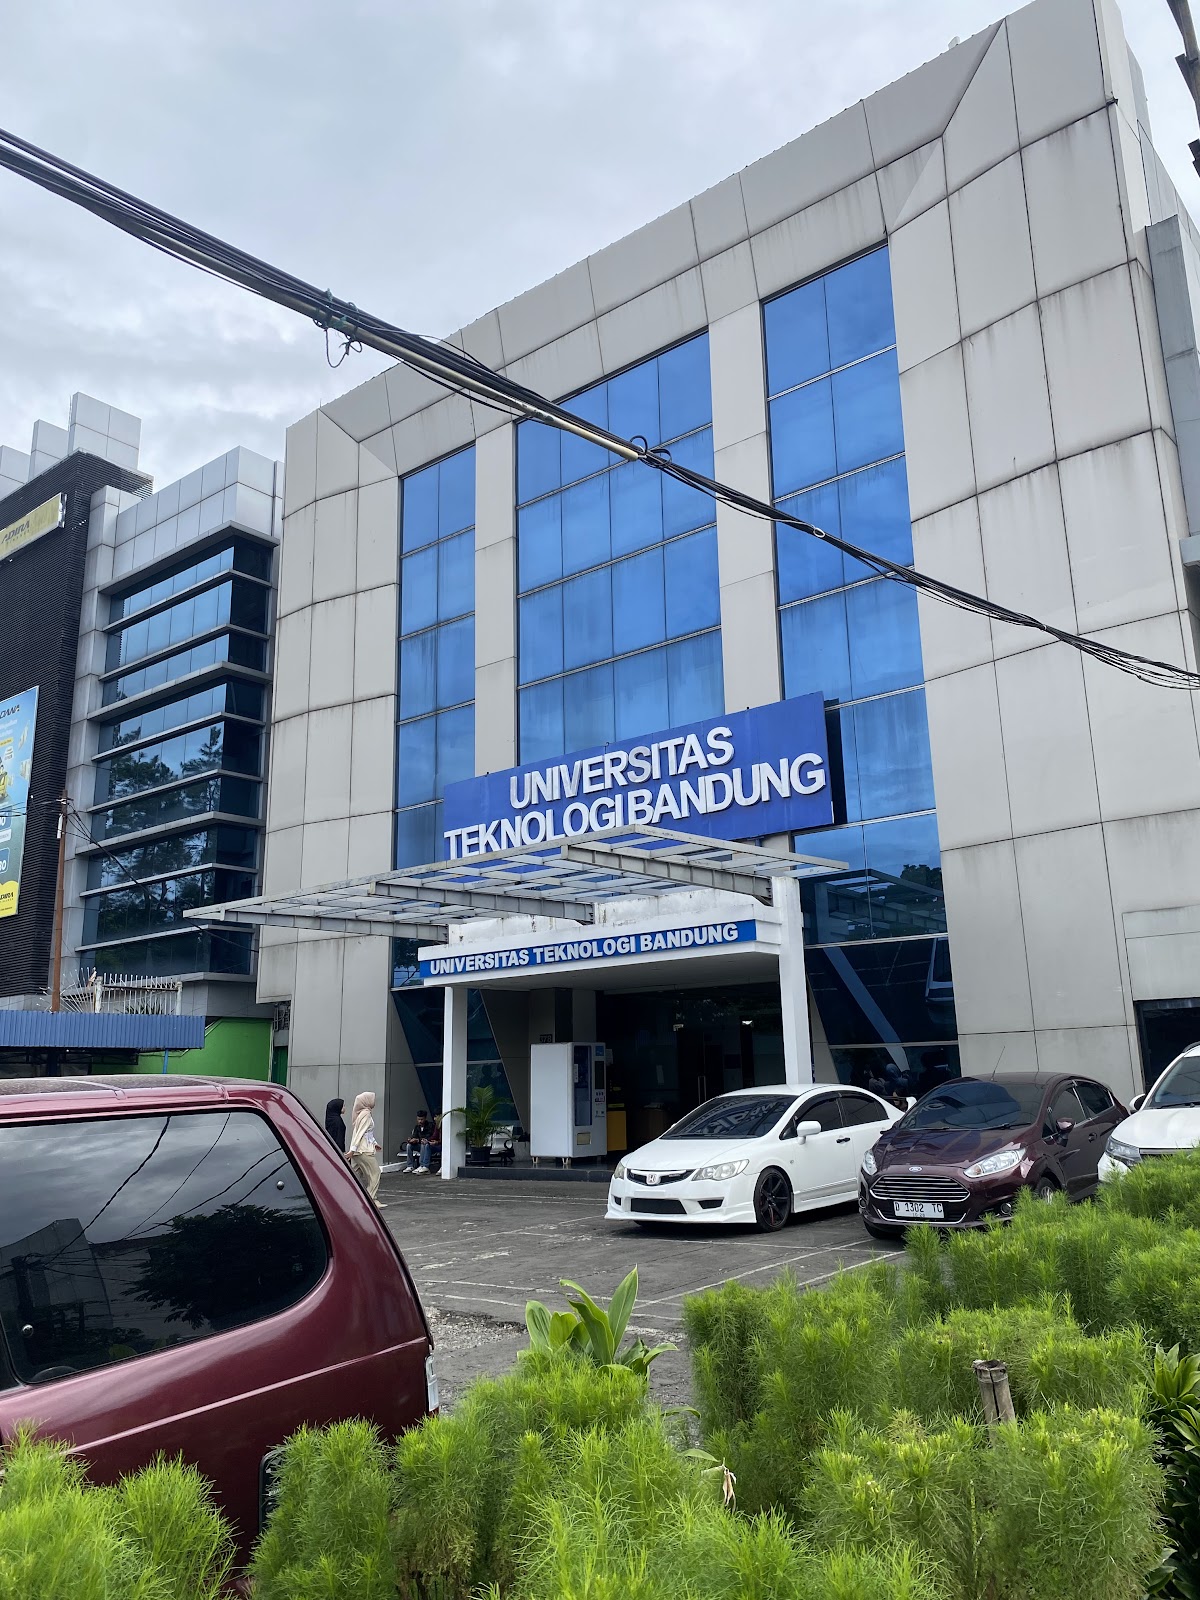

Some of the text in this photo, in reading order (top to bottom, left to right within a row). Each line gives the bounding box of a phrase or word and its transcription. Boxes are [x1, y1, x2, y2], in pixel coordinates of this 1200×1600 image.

[510, 726, 736, 809] UNIVERSITAS
[443, 752, 827, 860] TEKNOLOGI BANDUNG
[429, 922, 740, 975] UNIVERSITAS TEKNOLOGI BANDUNG
[895, 1201, 943, 1213] D 1302 TC
